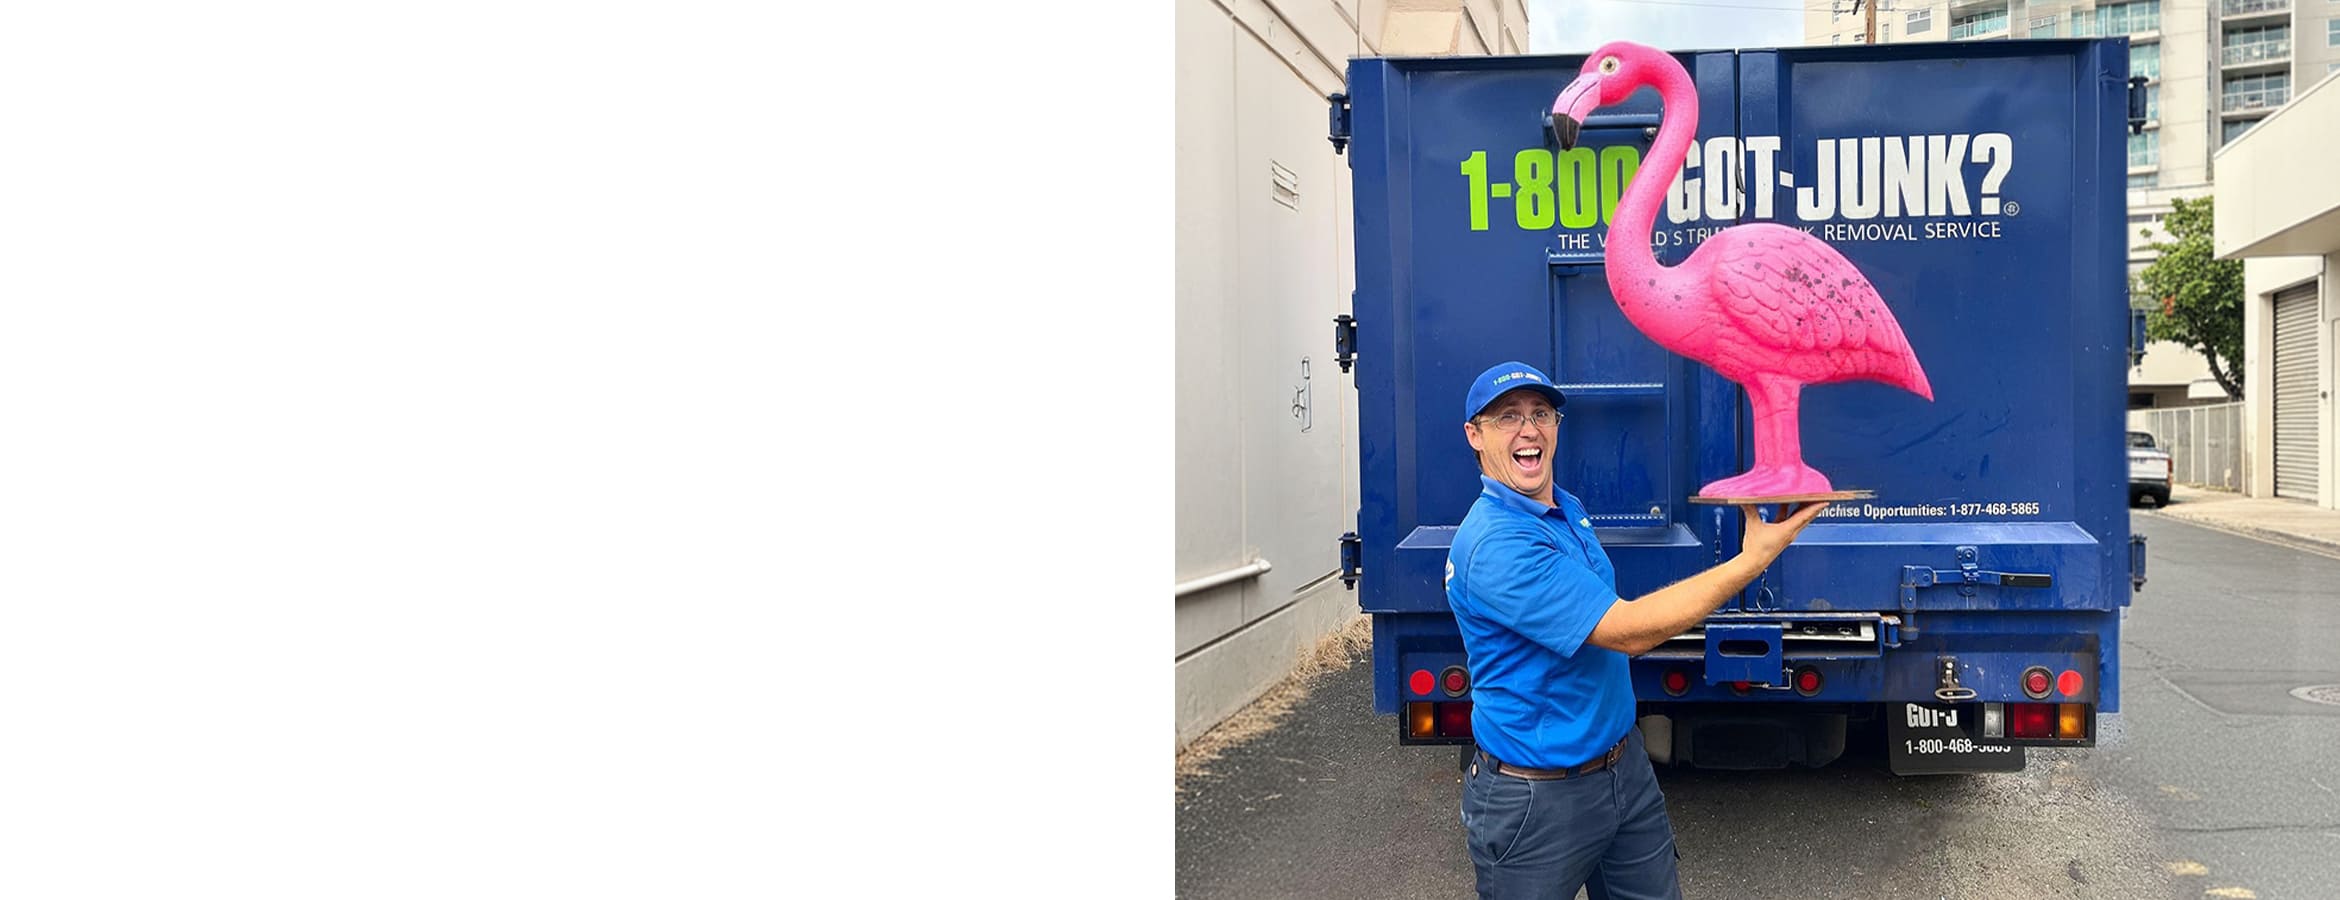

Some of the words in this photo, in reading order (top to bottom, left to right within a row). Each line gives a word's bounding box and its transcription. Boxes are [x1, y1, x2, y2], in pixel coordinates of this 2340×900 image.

[1558, 233, 1590, 249] THE
[1824, 223, 1918, 241] REMOVAL
[1924, 221, 2001, 239] SERVICE
[1864, 503, 1948, 521] Opportunities:
[1950, 502, 2040, 516] 1-877-468-5865
